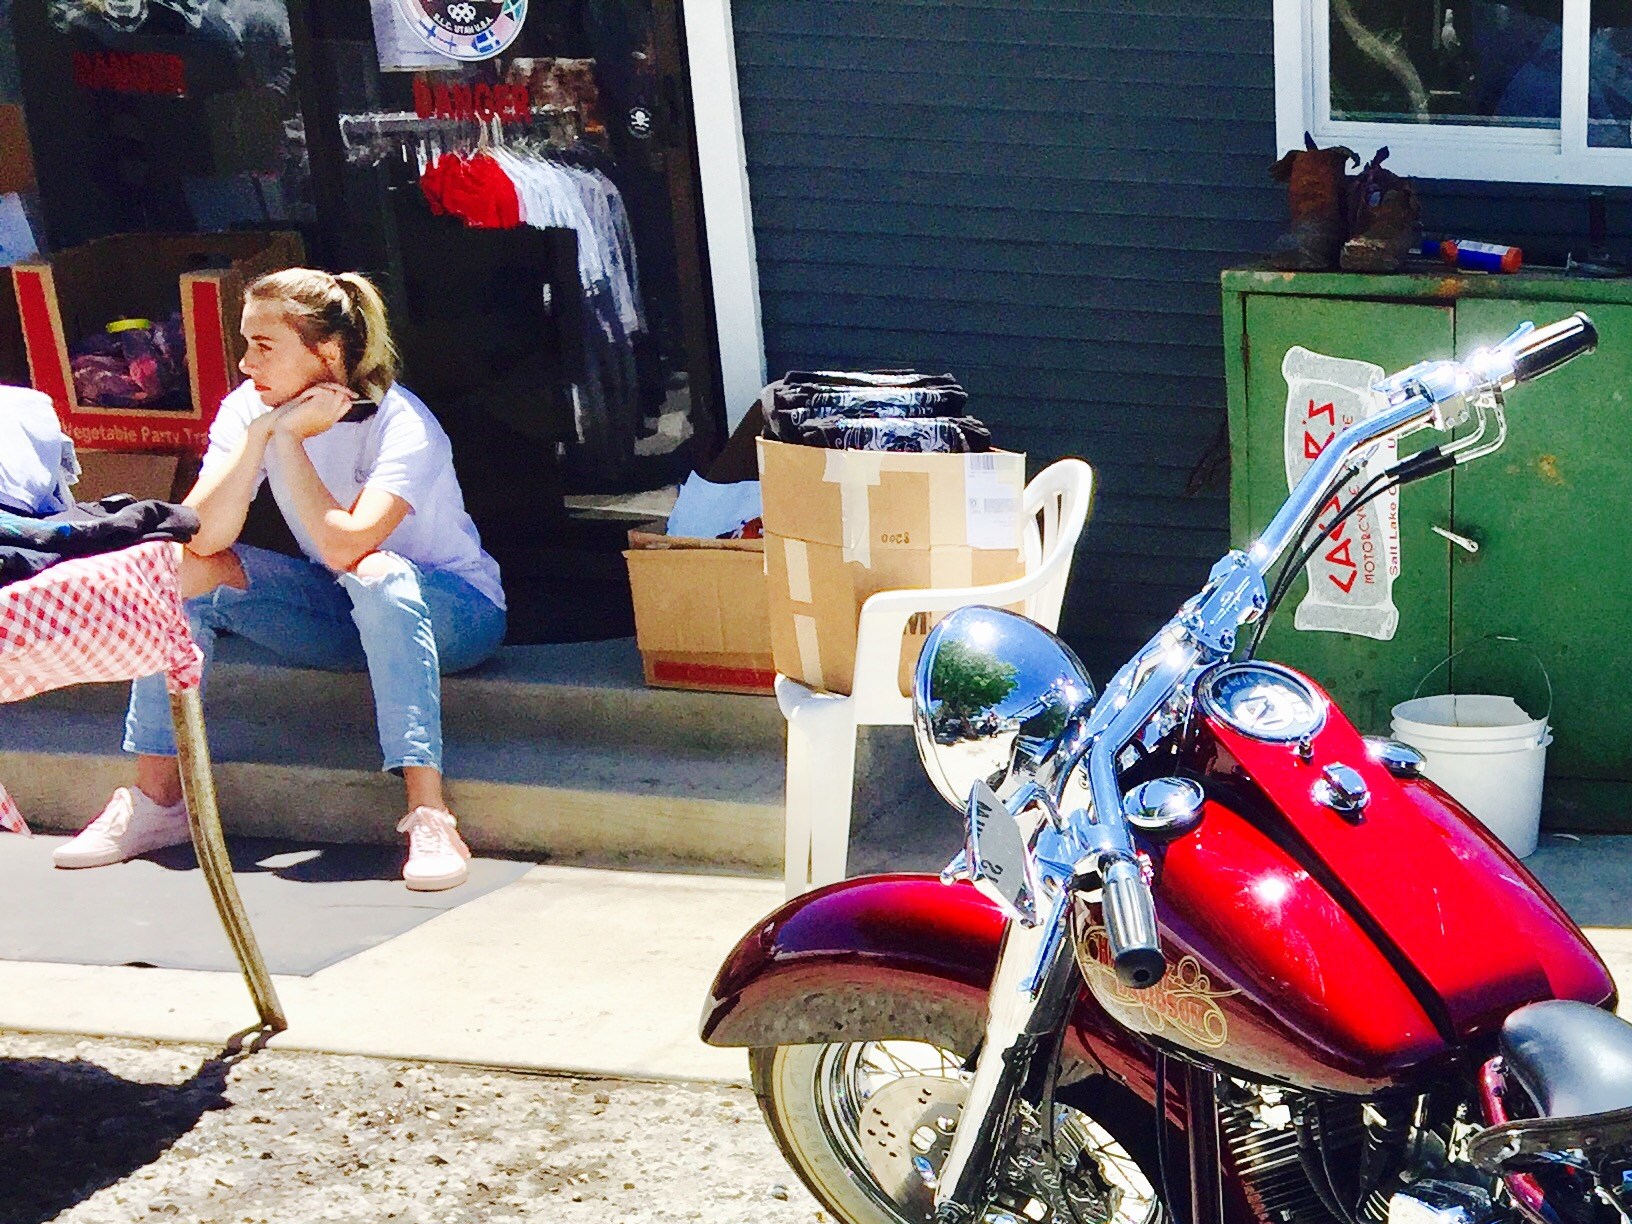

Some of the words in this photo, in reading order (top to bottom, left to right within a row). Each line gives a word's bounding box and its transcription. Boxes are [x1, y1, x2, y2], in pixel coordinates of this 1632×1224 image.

[412, 78, 532, 123] DANGER
[141, 425, 179, 445] Party
[1388, 501, 1398, 540] Lake
[1389, 545, 1398, 576] Salt
